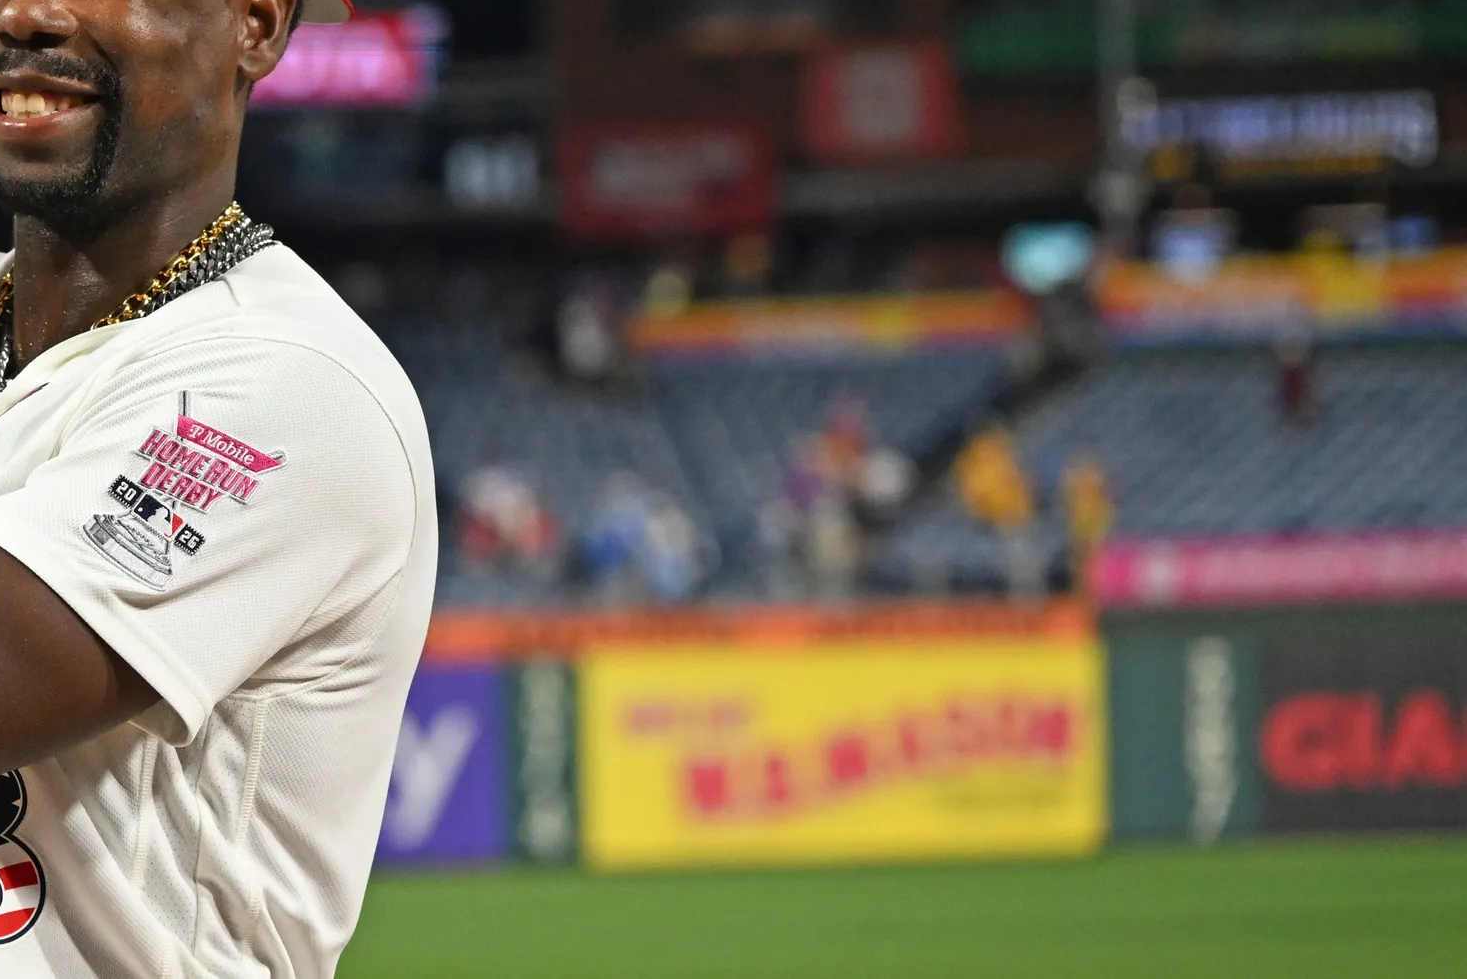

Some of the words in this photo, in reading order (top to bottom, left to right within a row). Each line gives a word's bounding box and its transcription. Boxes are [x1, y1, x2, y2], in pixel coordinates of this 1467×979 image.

[138, 428, 213, 479] HOME
[203, 457, 260, 501] RUN
[200, 430, 255, 465] Mobile
[115, 481, 137, 501] 20
[178, 530, 200, 549] 26
[139, 460, 224, 511] DERBY
[1258, 689, 1467, 791] GIA
